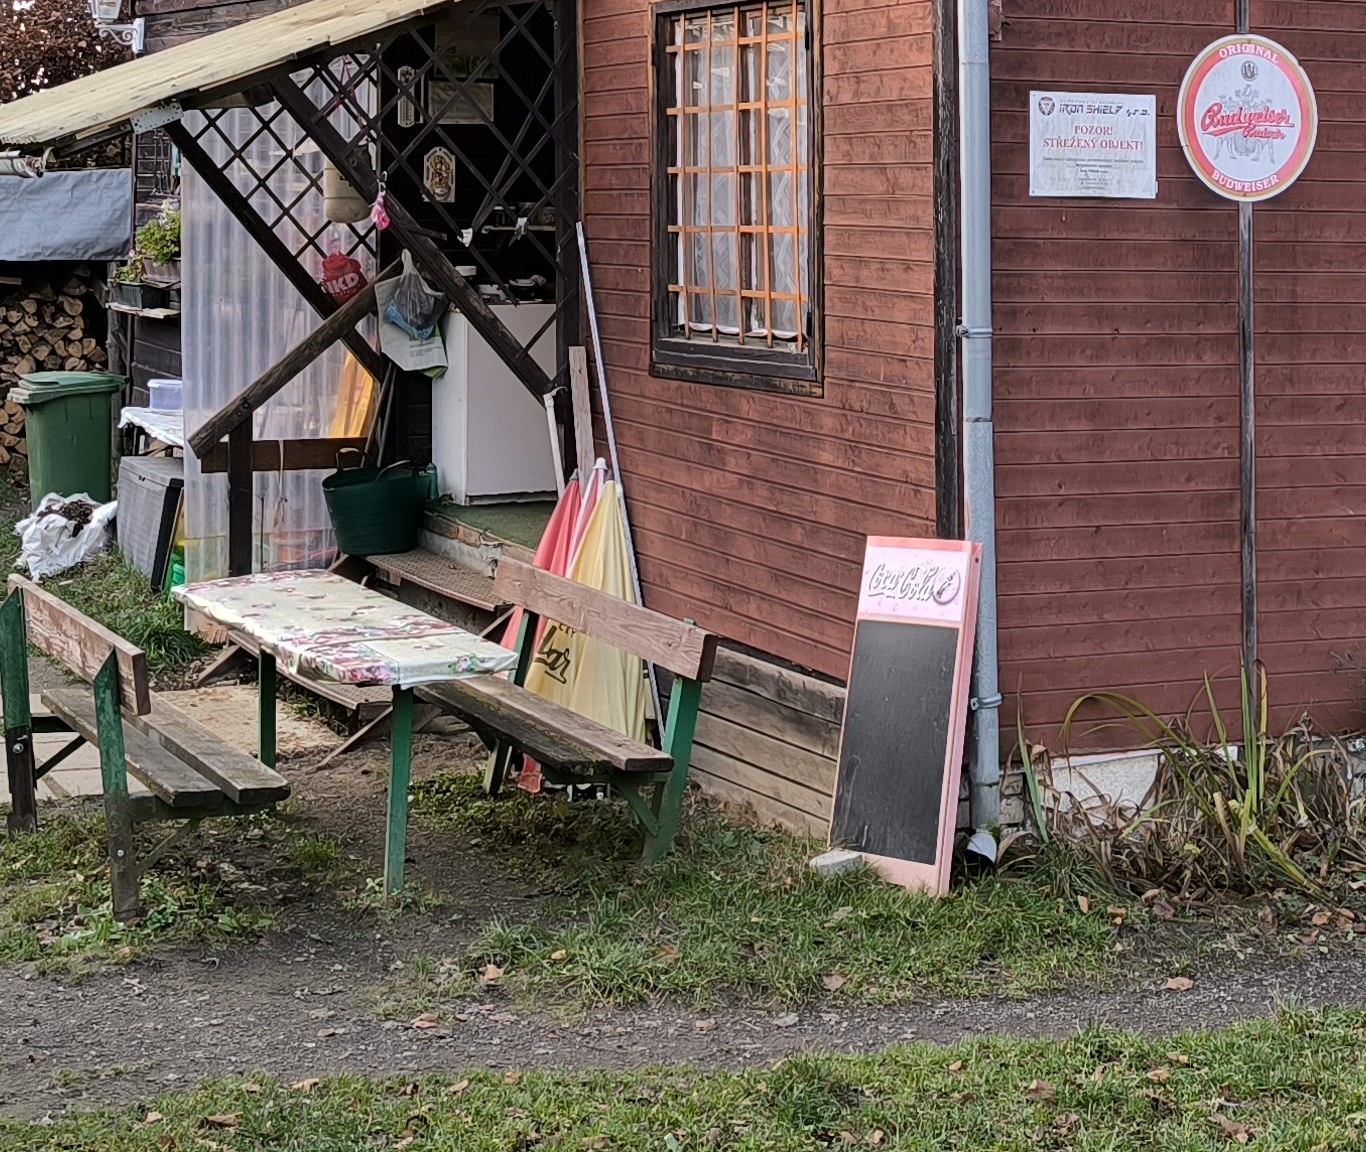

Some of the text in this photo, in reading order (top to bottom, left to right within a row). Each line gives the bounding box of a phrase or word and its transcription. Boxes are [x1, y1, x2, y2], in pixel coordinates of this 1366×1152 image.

[1218, 43, 1279, 64] ORIGINAL
[1201, 102, 1293, 133] Budweiser
[1074, 125, 1113, 135] POZOR!
[1100, 139, 1144, 150] OBJEKT!
[1211, 168, 1280, 192] BUDWEISER
